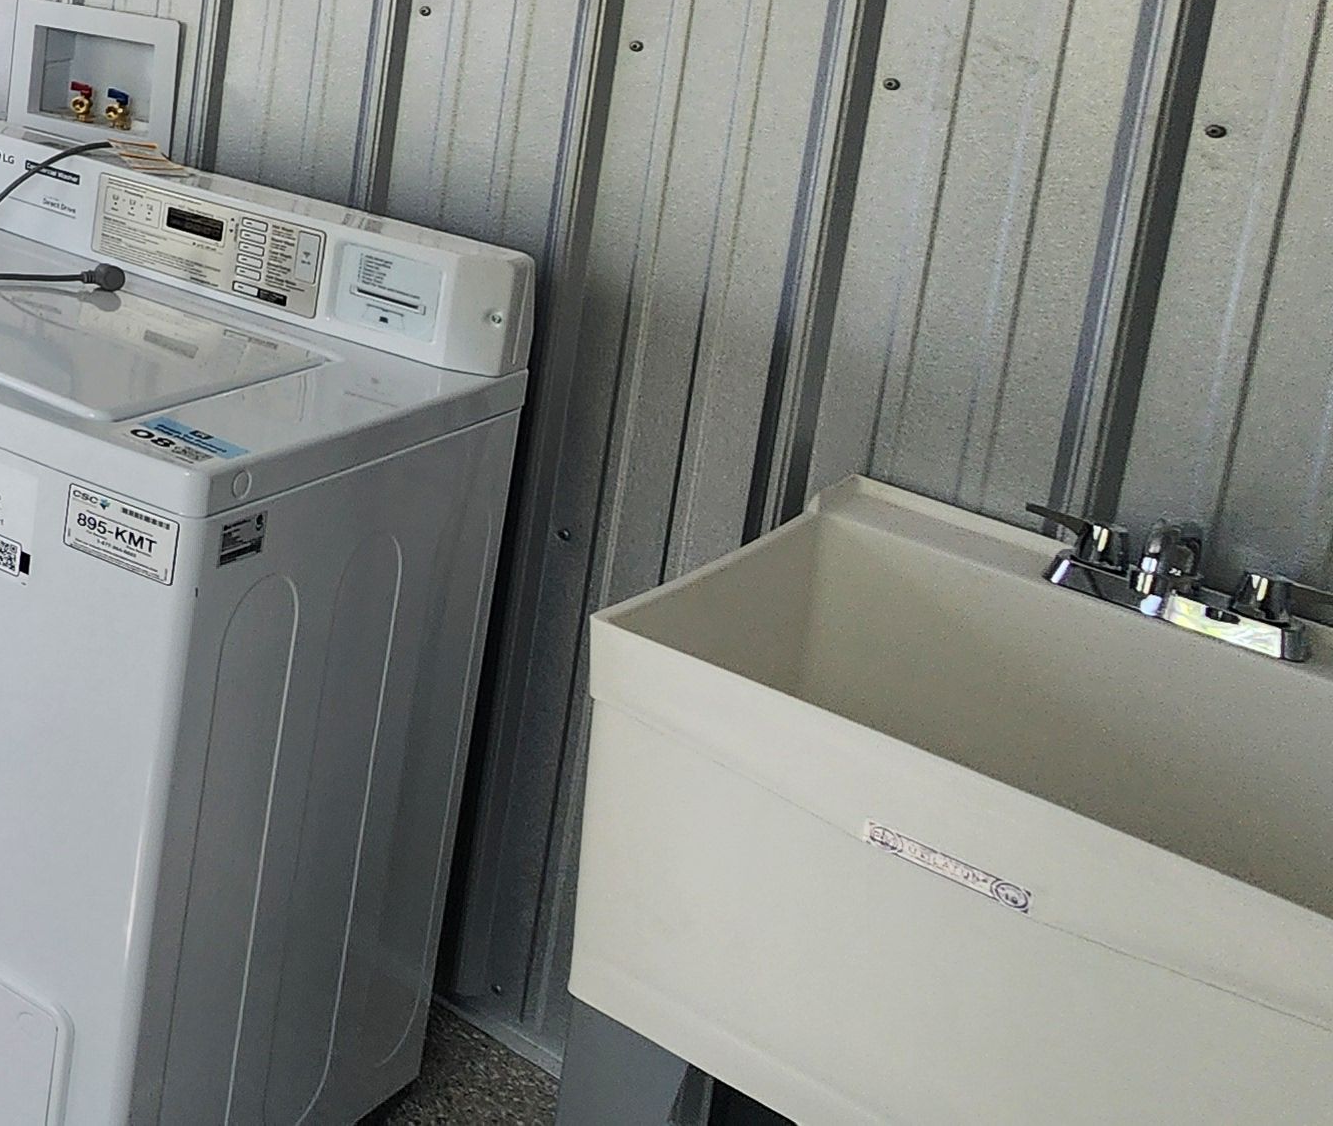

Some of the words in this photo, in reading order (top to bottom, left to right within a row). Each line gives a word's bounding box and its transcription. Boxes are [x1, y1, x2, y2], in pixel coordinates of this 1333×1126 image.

[3, 153, 15, 165] LG
[130, 429, 175, 447] 08
[73, 489, 98, 504] CSC
[77, 512, 157, 553] 895-KMT
